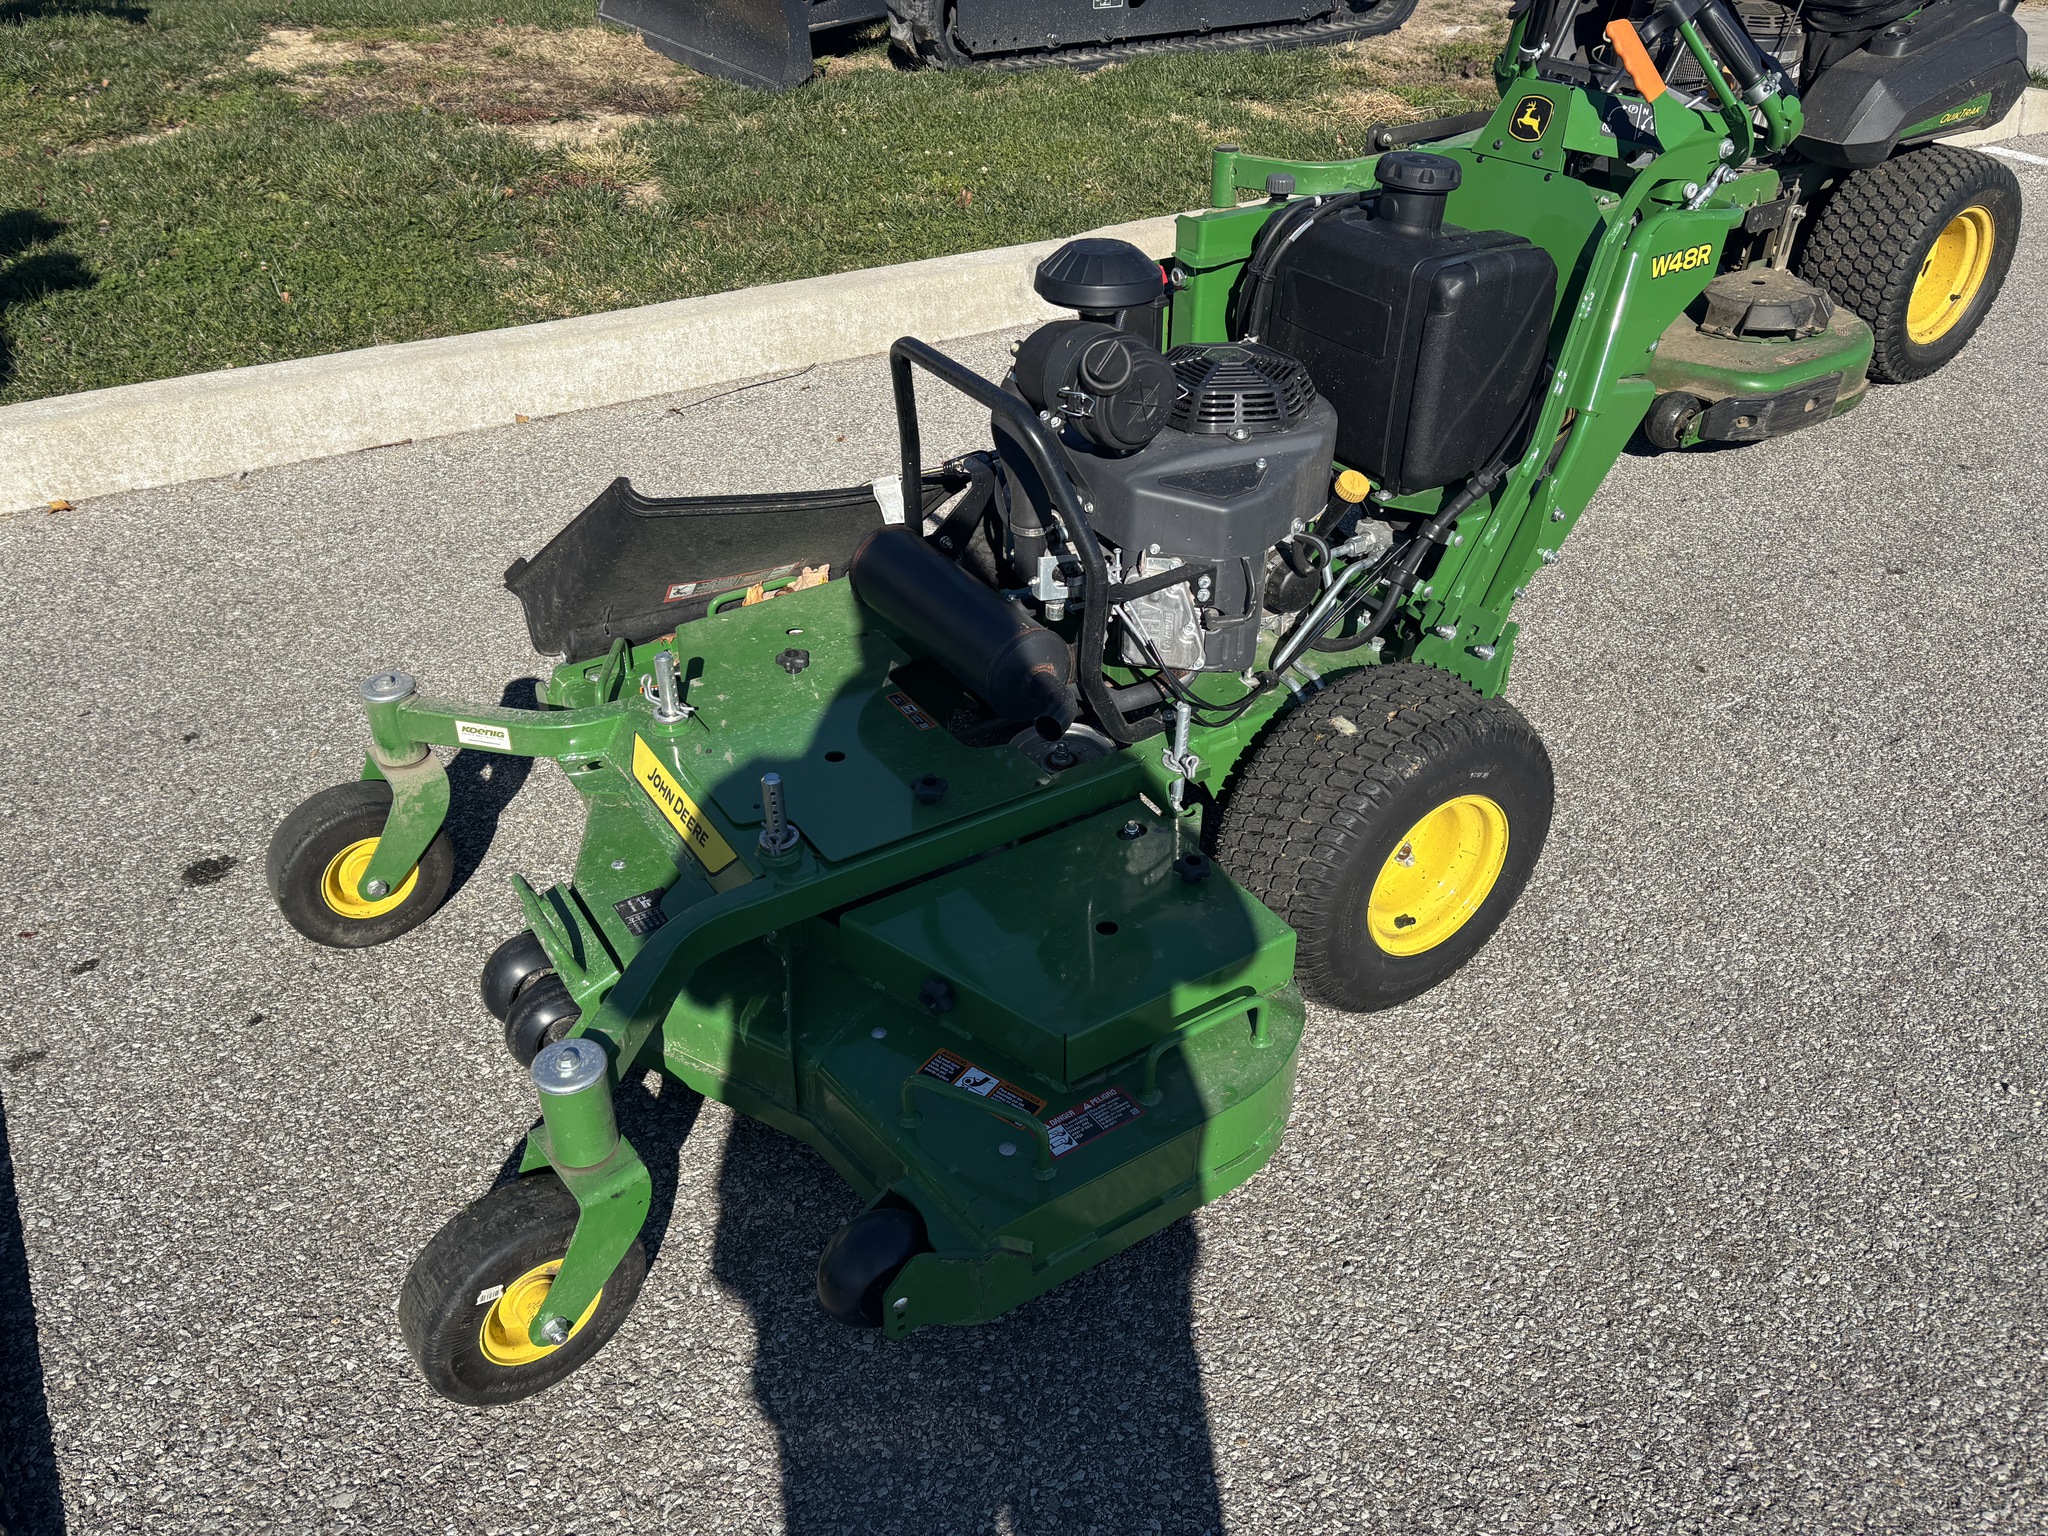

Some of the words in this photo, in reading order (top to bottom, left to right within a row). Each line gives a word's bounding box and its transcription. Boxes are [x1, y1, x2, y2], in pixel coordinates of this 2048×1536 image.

[1643, 107, 1649, 115] N
[1651, 242, 1713, 280] W48R
[647, 767, 675, 806] JOHN
[672, 796, 709, 848] DEERE
[1011, 1086, 1040, 1104] ADVERTENCIA
[1090, 1089, 1117, 1106] PELIGRO
[1049, 1110, 1076, 1126] DANGER
